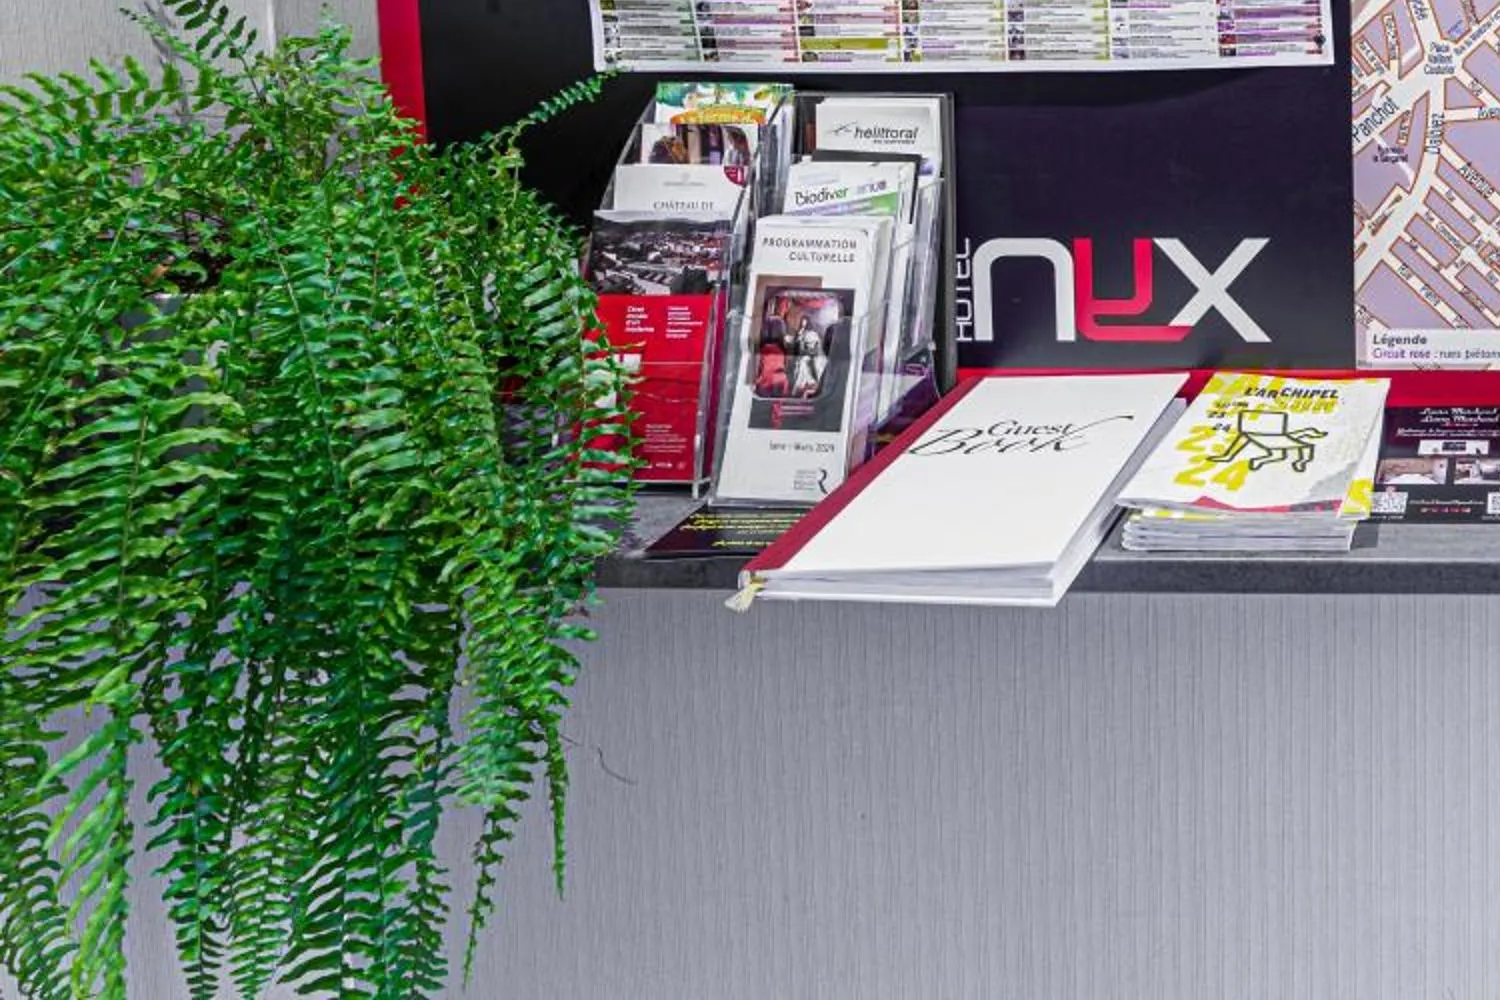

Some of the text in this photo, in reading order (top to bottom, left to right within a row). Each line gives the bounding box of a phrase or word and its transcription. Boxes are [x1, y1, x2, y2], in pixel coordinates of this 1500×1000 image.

[762, 237, 857, 249] PROGRAMMATION
[788, 251, 856, 262] CULTURELLE
[1372, 333, 1428, 347] Légende
[987, 419, 1073, 438] Guest
[909, 427, 1092, 457] Book
